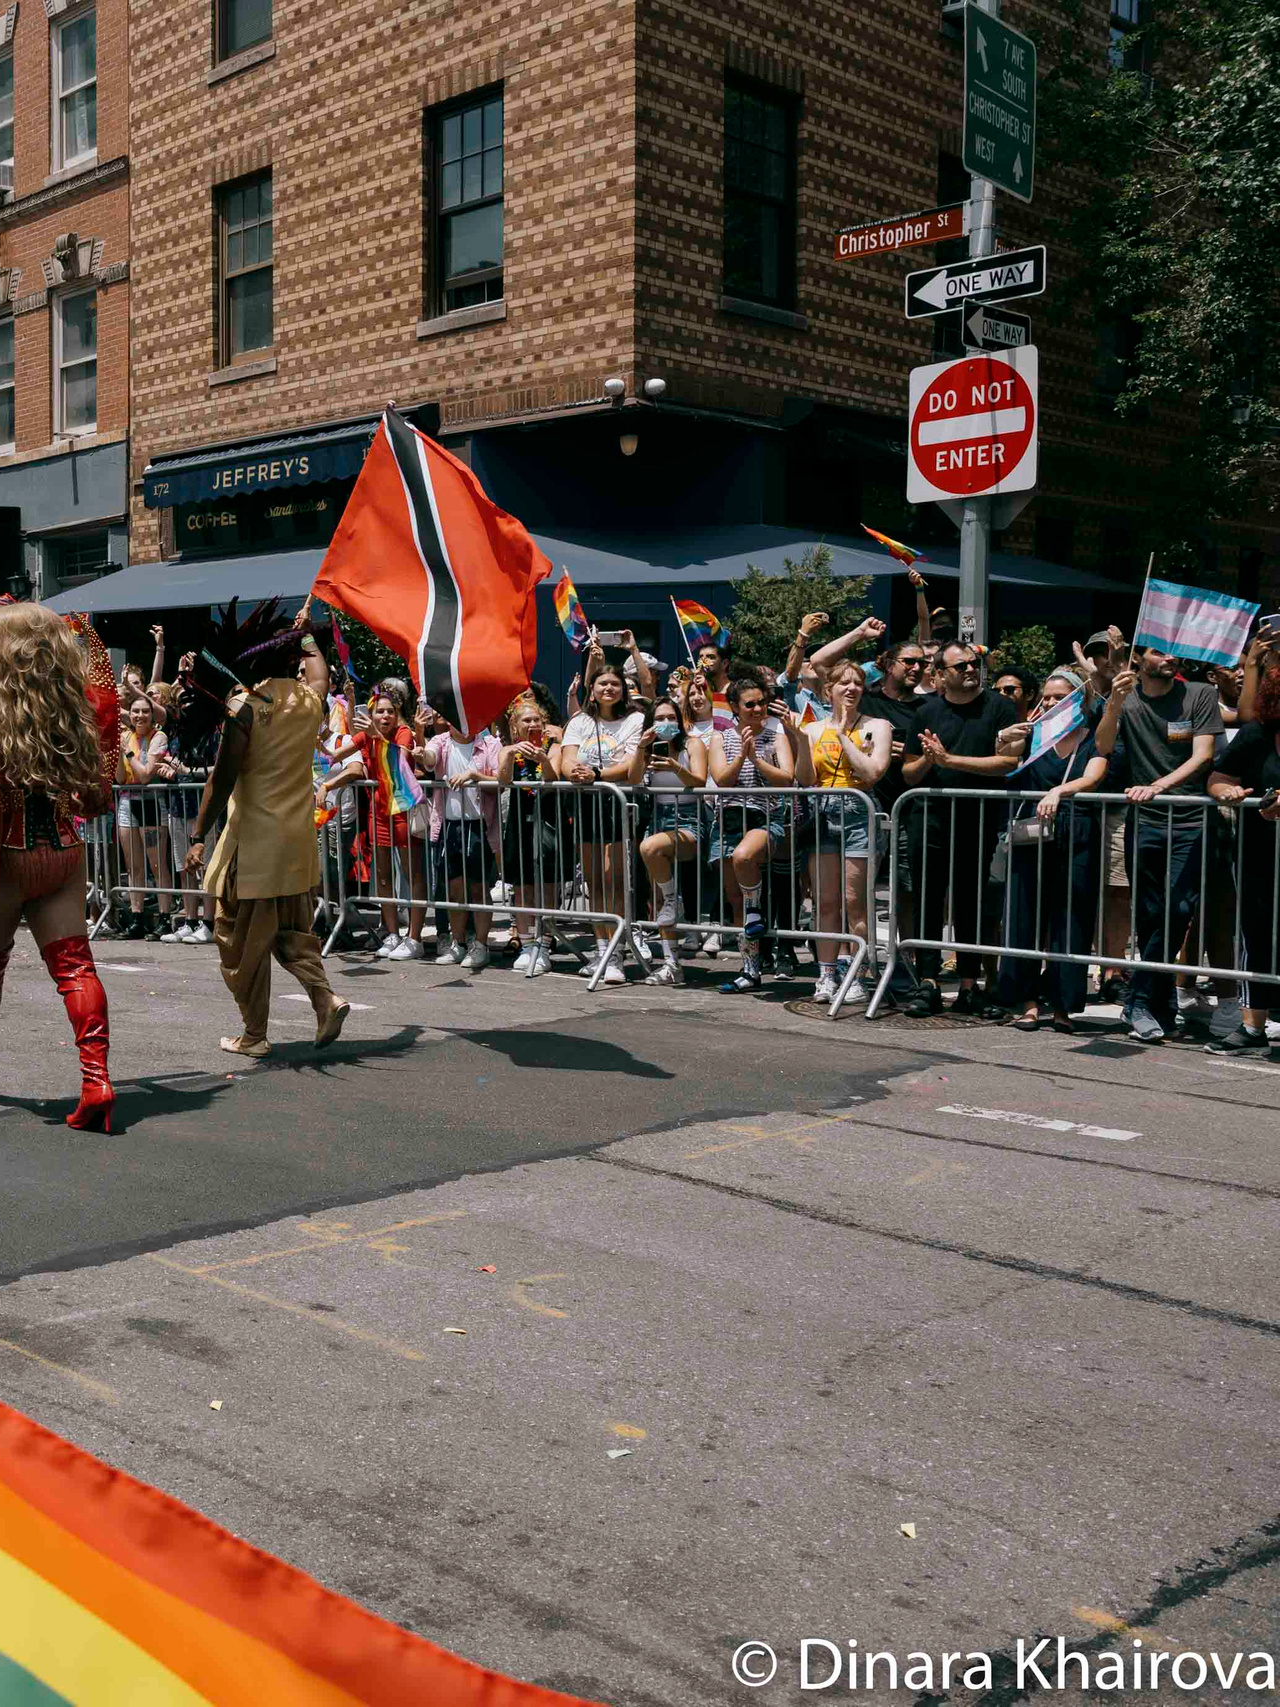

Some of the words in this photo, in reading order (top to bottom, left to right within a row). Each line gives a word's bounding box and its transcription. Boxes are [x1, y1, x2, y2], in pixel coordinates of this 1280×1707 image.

[1004, 38, 1009, 60] 7
[1011, 44, 1025, 70] AVE
[1002, 69, 1026, 102] SOUTH
[969, 91, 1020, 139] CHRISTOPHER
[1021, 122, 1032, 145] ST
[975, 133, 996, 164] WEST
[839, 221, 931, 255] Christopher
[937, 213, 949, 228] St
[946, 274, 982, 296] ONE
[989, 264, 1028, 287] WAY
[982, 320, 1000, 339] ONE
[1003, 323, 1023, 344] WAY
[929, 390, 957, 414] DO
[971, 379, 1015, 407] NOT
[935, 443, 1005, 472] ENTER
[153, 483, 169, 498] 172
[212, 456, 309, 490] JEFFREY'S
[187, 511, 237, 530] COFFEE
